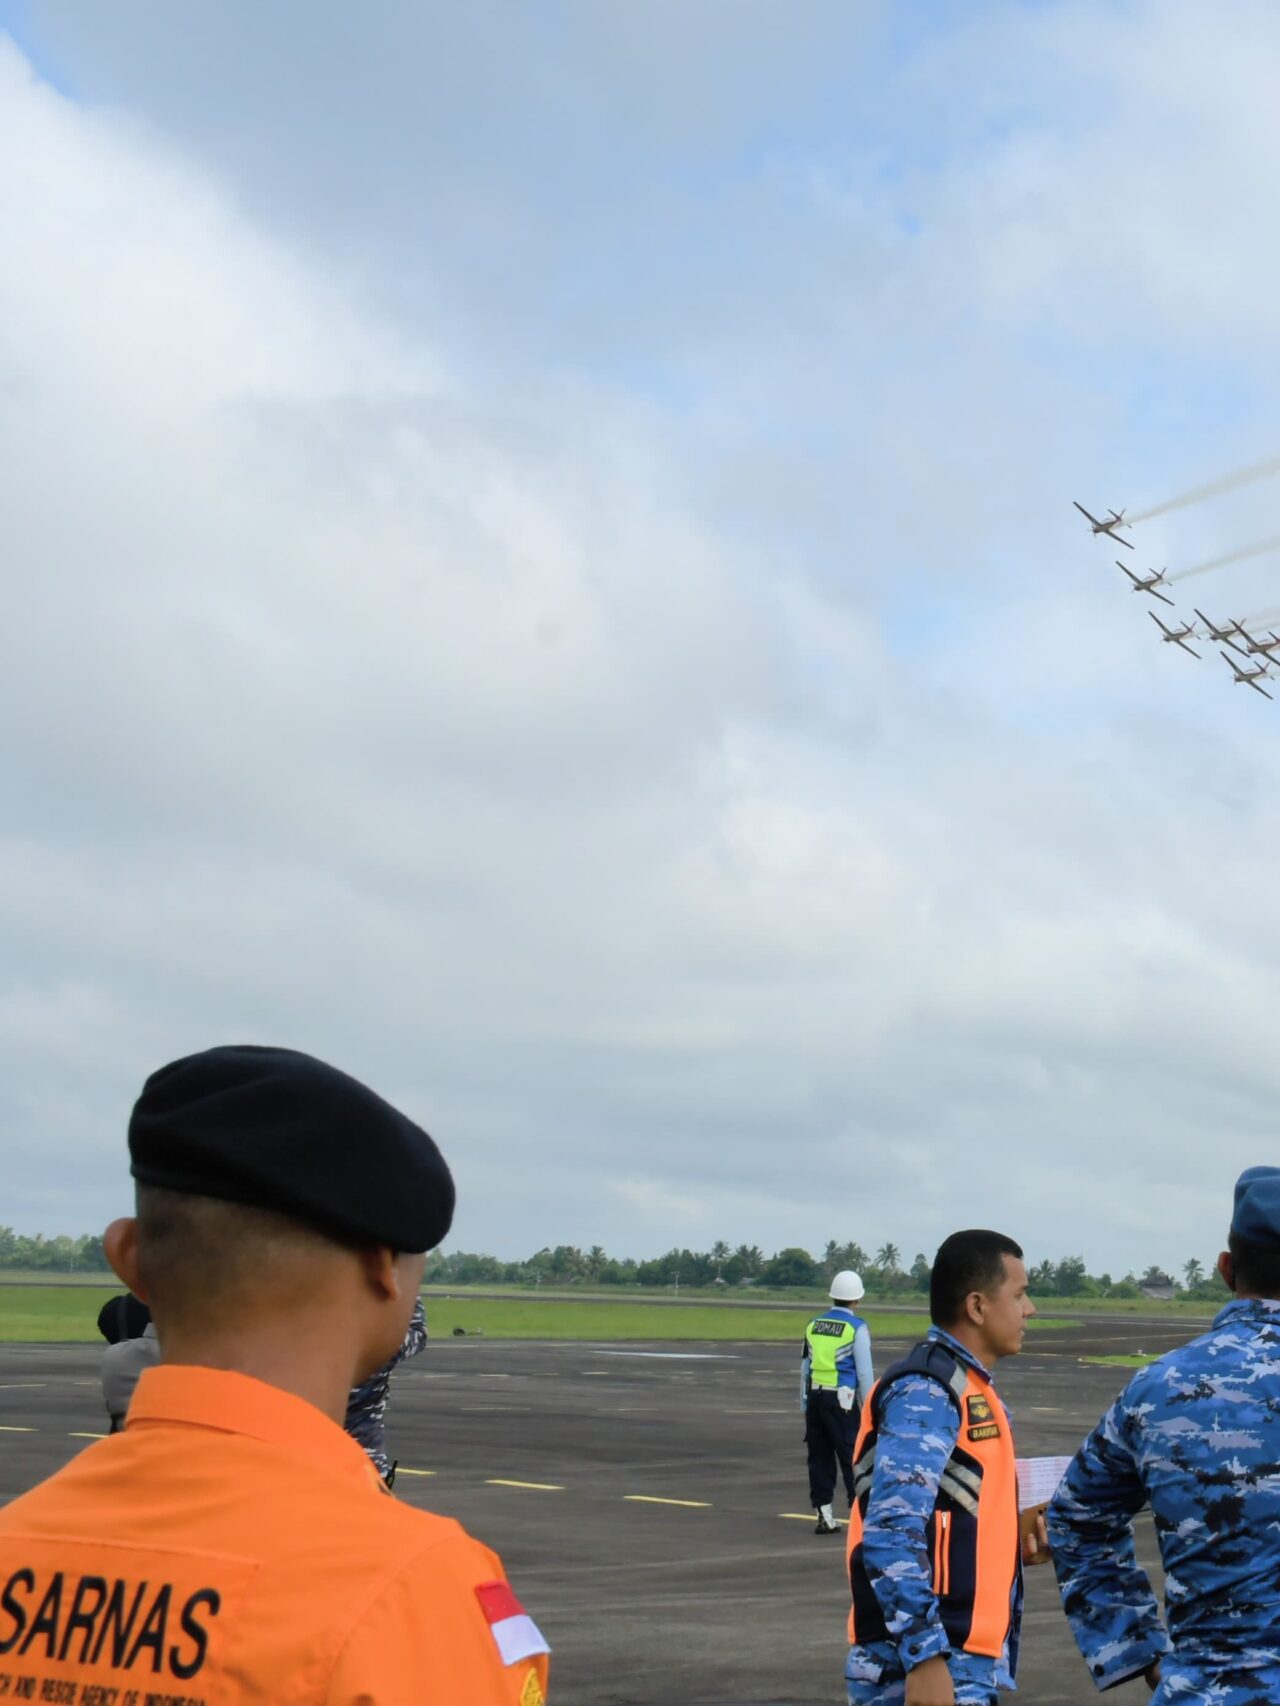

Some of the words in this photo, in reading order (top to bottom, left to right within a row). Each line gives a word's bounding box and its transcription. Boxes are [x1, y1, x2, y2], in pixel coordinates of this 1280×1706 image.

[814, 1322, 842, 1335] POMAU
[0, 1567, 221, 1680] SARNAS
[13, 1675, 36, 1700] AND
[41, 1678, 77, 1705] RESCUE
[80, 1683, 119, 1706] AGENCY
[122, 1690, 139, 1706] OF
